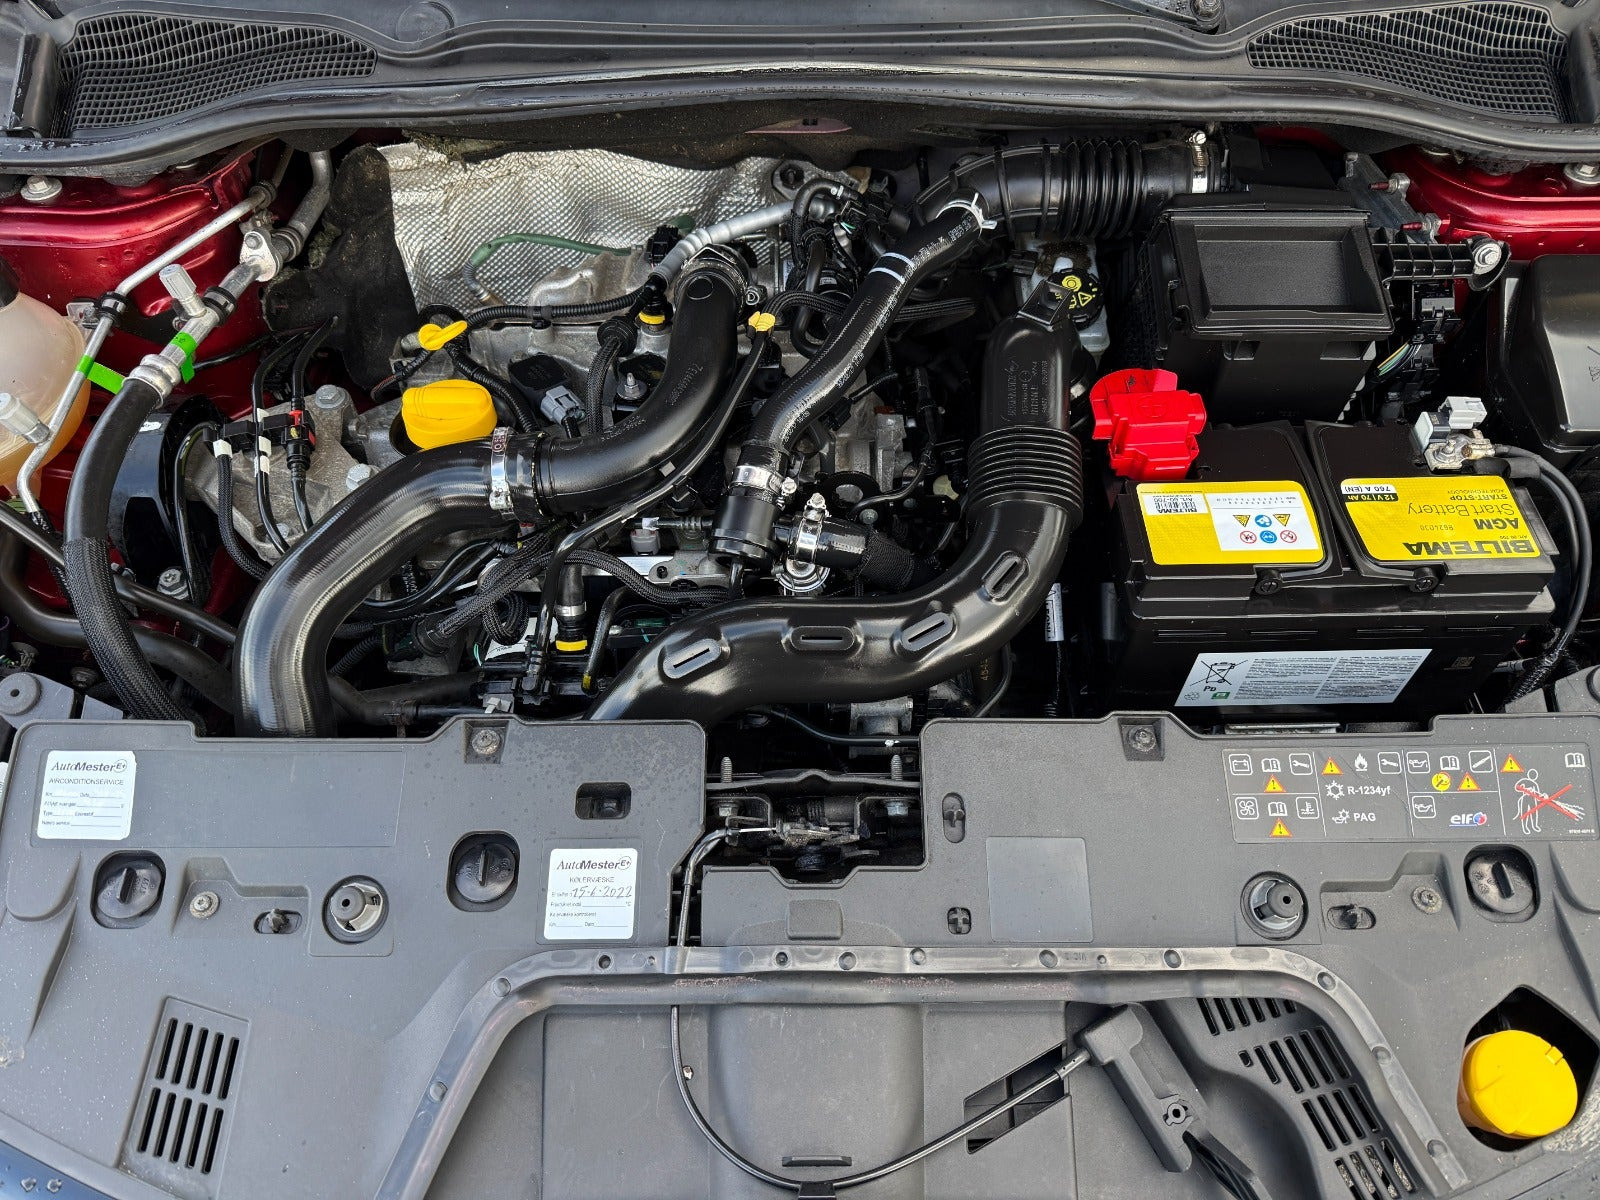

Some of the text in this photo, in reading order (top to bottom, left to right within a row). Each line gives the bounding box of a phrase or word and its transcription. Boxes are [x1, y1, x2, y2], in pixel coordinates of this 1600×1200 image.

[1407, 502, 1515, 517] Start Battery
[1473, 517, 1519, 530] AGM
[1402, 540, 1535, 556] BILTEMA
[48, 777, 125, 786] AIRCONDITIONSERVICE
[1347, 785, 1391, 797] R-1234yf
[1353, 812, 1377, 822] PAG
[1450, 813, 1474, 825] elf
